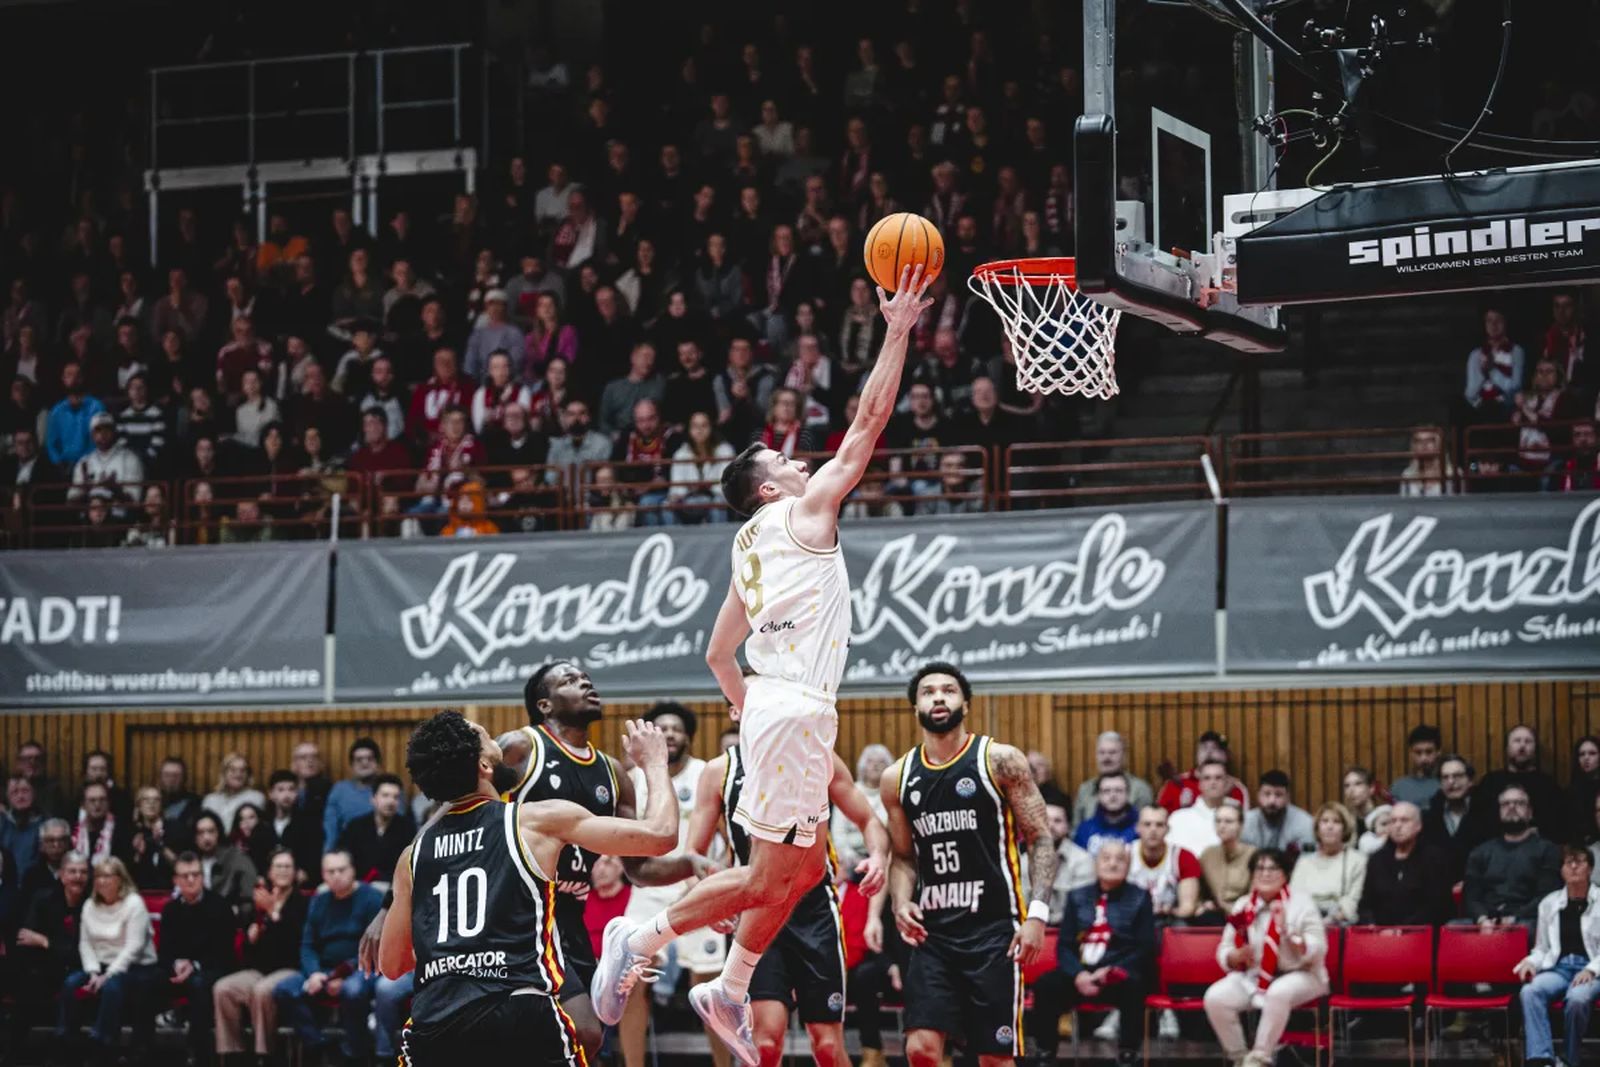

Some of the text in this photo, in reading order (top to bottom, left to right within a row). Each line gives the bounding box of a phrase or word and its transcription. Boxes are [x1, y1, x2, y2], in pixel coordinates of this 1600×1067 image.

[1349, 218, 1600, 266] spindler
[1397, 249, 1583, 273] WILLKOMMEN BEIM BESTEN TEAM
[0, 595, 121, 643] ADT!
[26, 667, 320, 693] stadtbau-wuerzburg.de/karriere
[434, 827, 484, 859] MINTZ
[932, 840, 960, 874] 55
[432, 866, 487, 943] 10
[920, 880, 984, 913] KNAUF
[425, 951, 506, 979] MERCATOR
